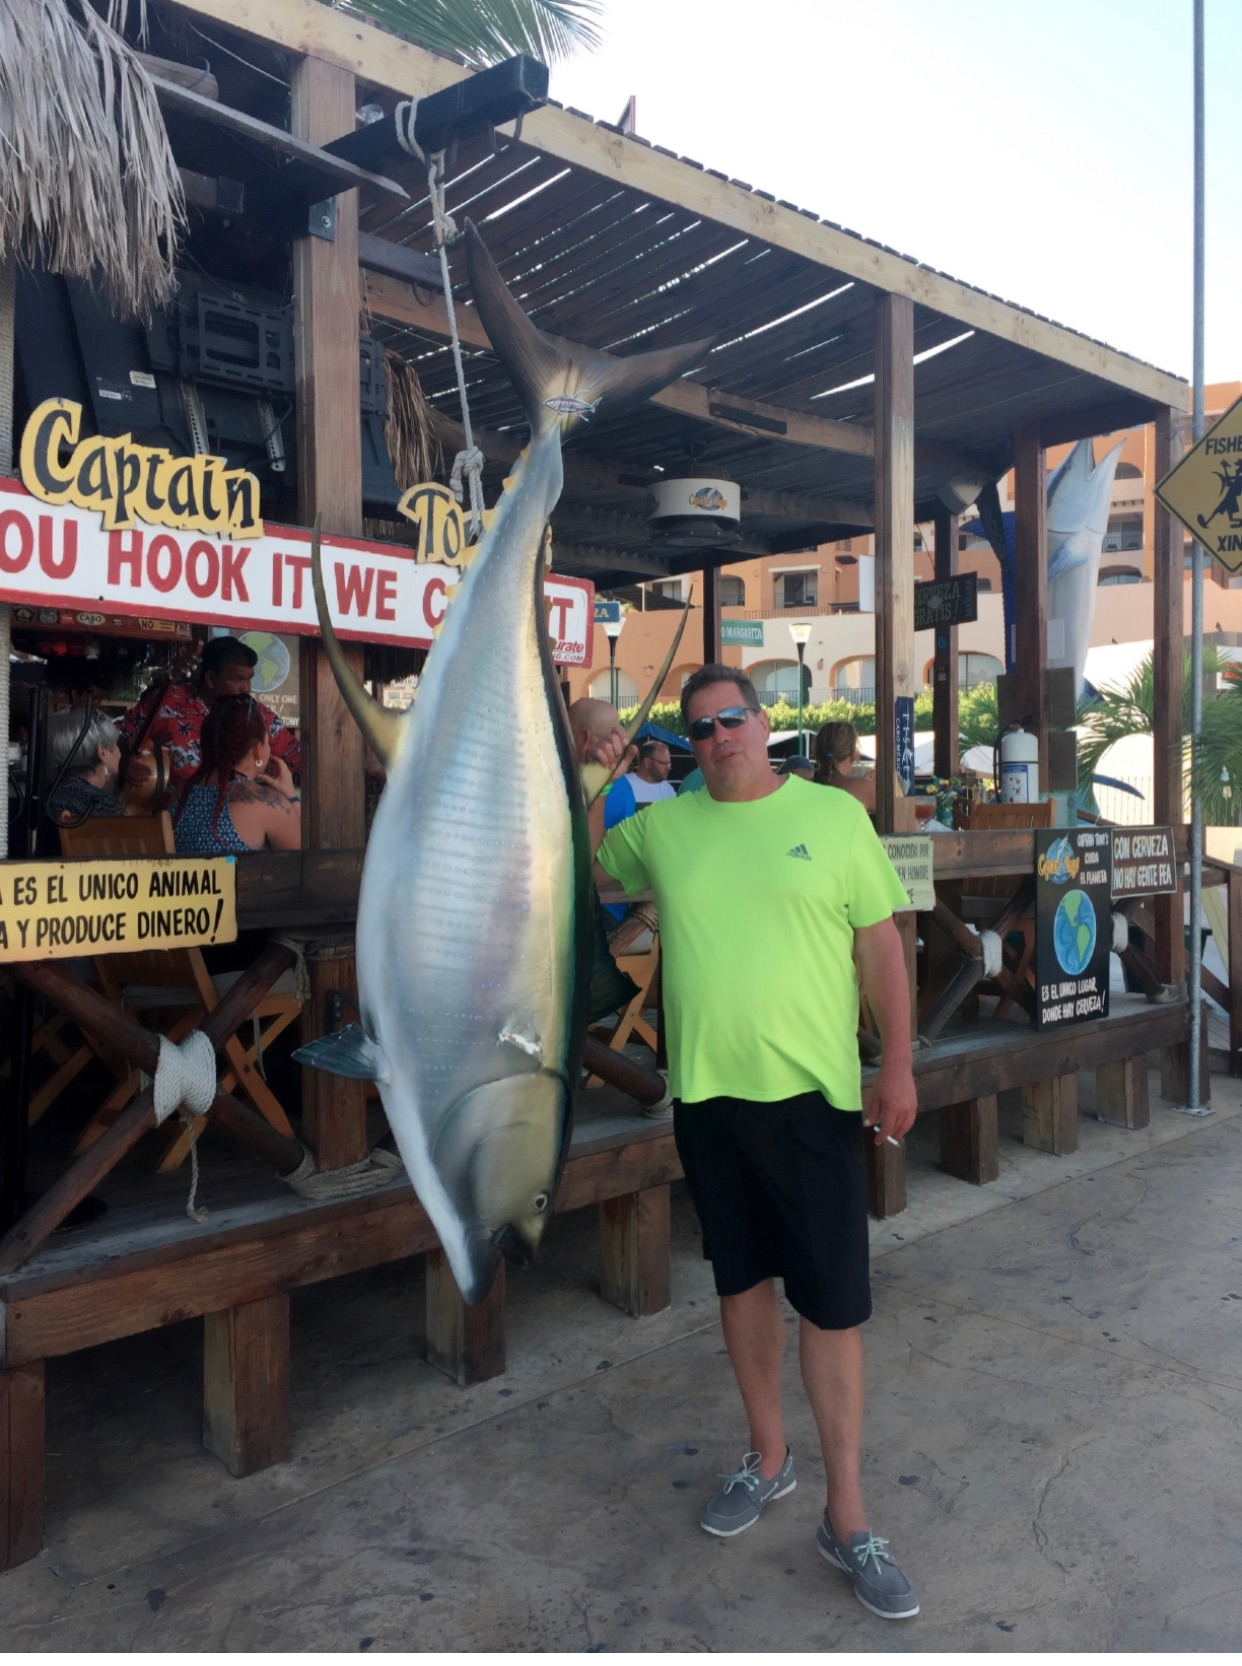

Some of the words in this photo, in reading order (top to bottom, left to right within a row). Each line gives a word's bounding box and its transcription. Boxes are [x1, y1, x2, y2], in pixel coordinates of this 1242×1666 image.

[34, 409, 255, 528] Captain
[107, 529, 251, 602] HOOK
[273, 553, 312, 609] IT
[334, 562, 397, 620] WE
[79, 613, 102, 623] CABO
[141, 618, 154, 629] NO
[259, 693, 280, 704] ONLY
[281, 694, 298, 705] ONE
[888, 843, 918, 860] CONOCIDA
[1113, 836, 1130, 860] CON
[1132, 834, 1168, 858] CERVEZA
[907, 865, 929, 880] HOMBRE
[1080, 872, 1086, 885] EL
[1087, 870, 1107, 885] PLANETA
[1113, 867, 1123, 890] NO
[1124, 866, 1136, 888] HAY
[1137, 864, 1157, 887] GENTE
[1159, 863, 1172, 886] FEA
[14, 877, 37, 905] ES
[48, 875, 67, 903] EL
[79, 873, 138, 901] UNICO
[149, 870, 221, 898] ANIMAL
[17, 919, 30, 948] Y
[37, 913, 126, 947] PRODUCE
[138, 899, 223, 943] DINERO!
[1041, 985, 1049, 1002] ES
[1050, 984, 1058, 999] EL
[1059, 981, 1076, 997] UNICO
[1042, 1004, 1062, 1024] DONDE
[1063, 1001, 1075, 1018] HAY
